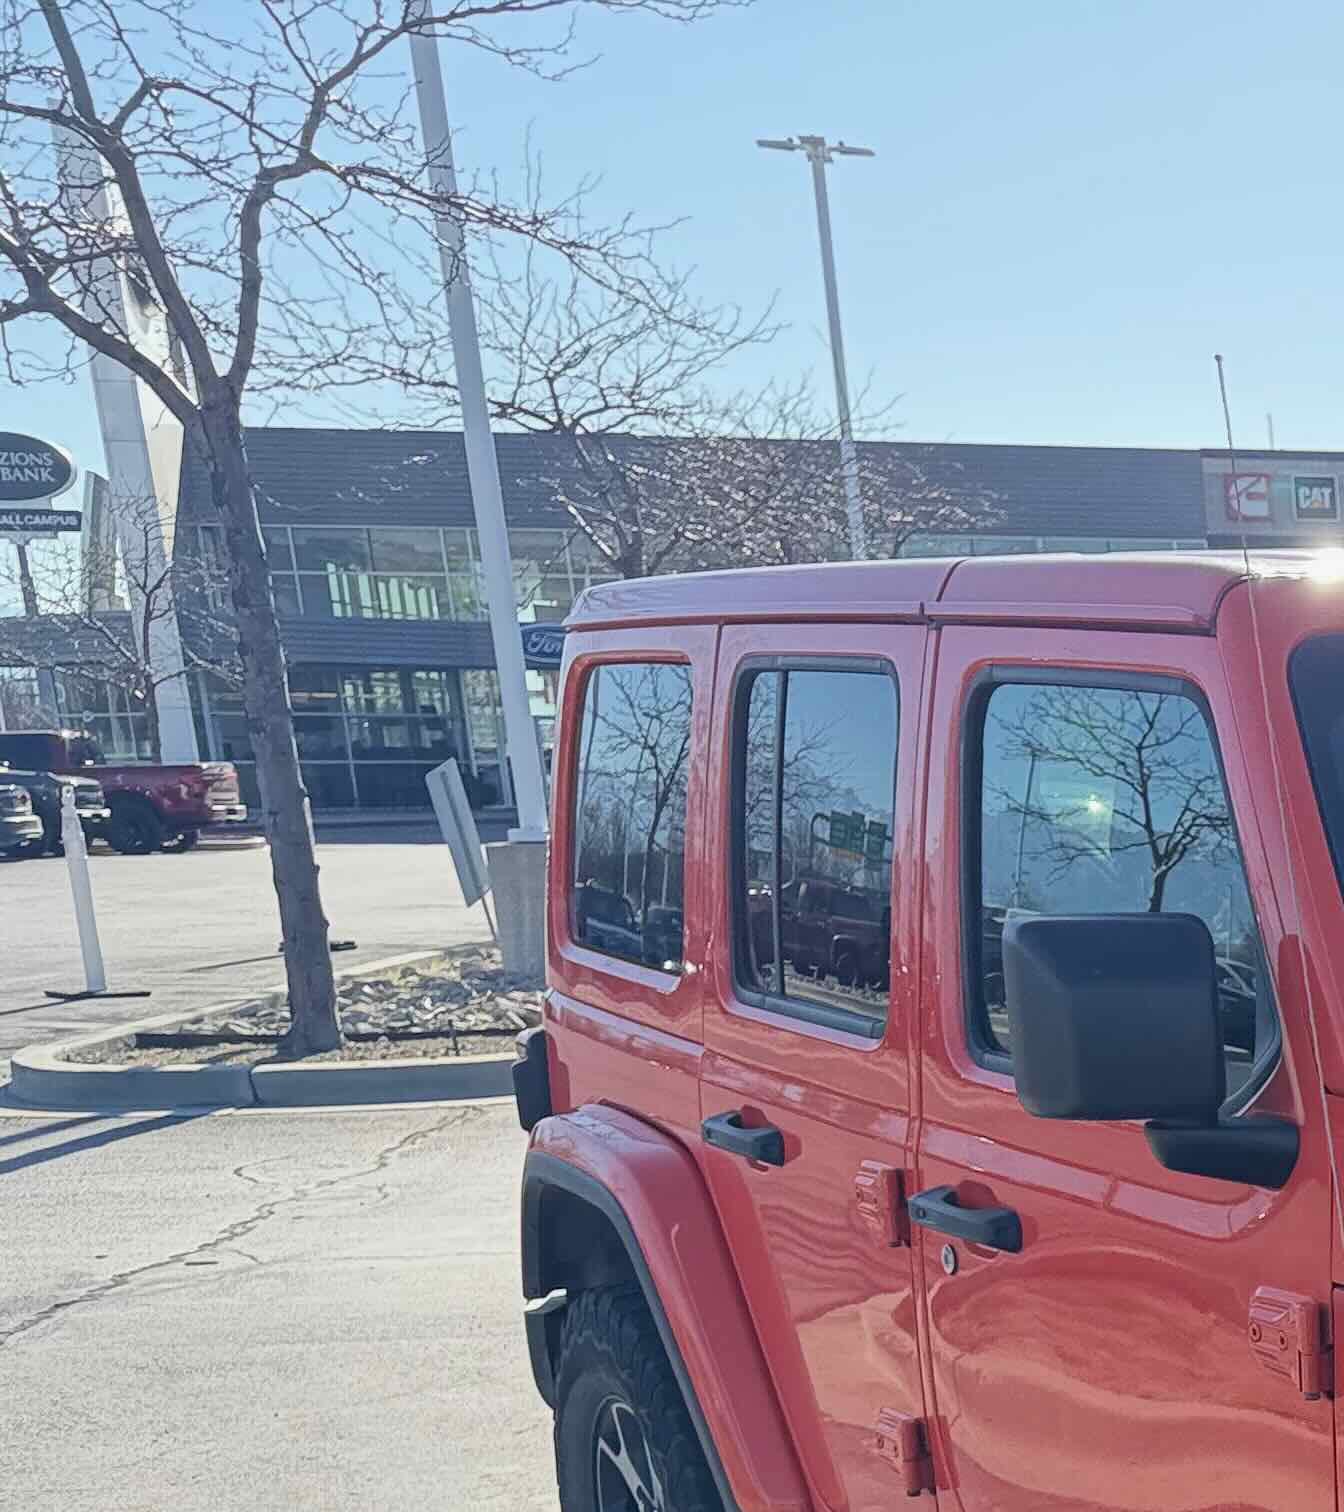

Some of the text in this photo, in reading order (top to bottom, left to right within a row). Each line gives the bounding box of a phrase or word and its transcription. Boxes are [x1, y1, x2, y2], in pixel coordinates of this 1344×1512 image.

[0, 452, 53, 466] ZIONS
[0, 467, 55, 482] BANK
[1297, 486, 1333, 510] CAT
[24, 514, 79, 527] CAMPUS
